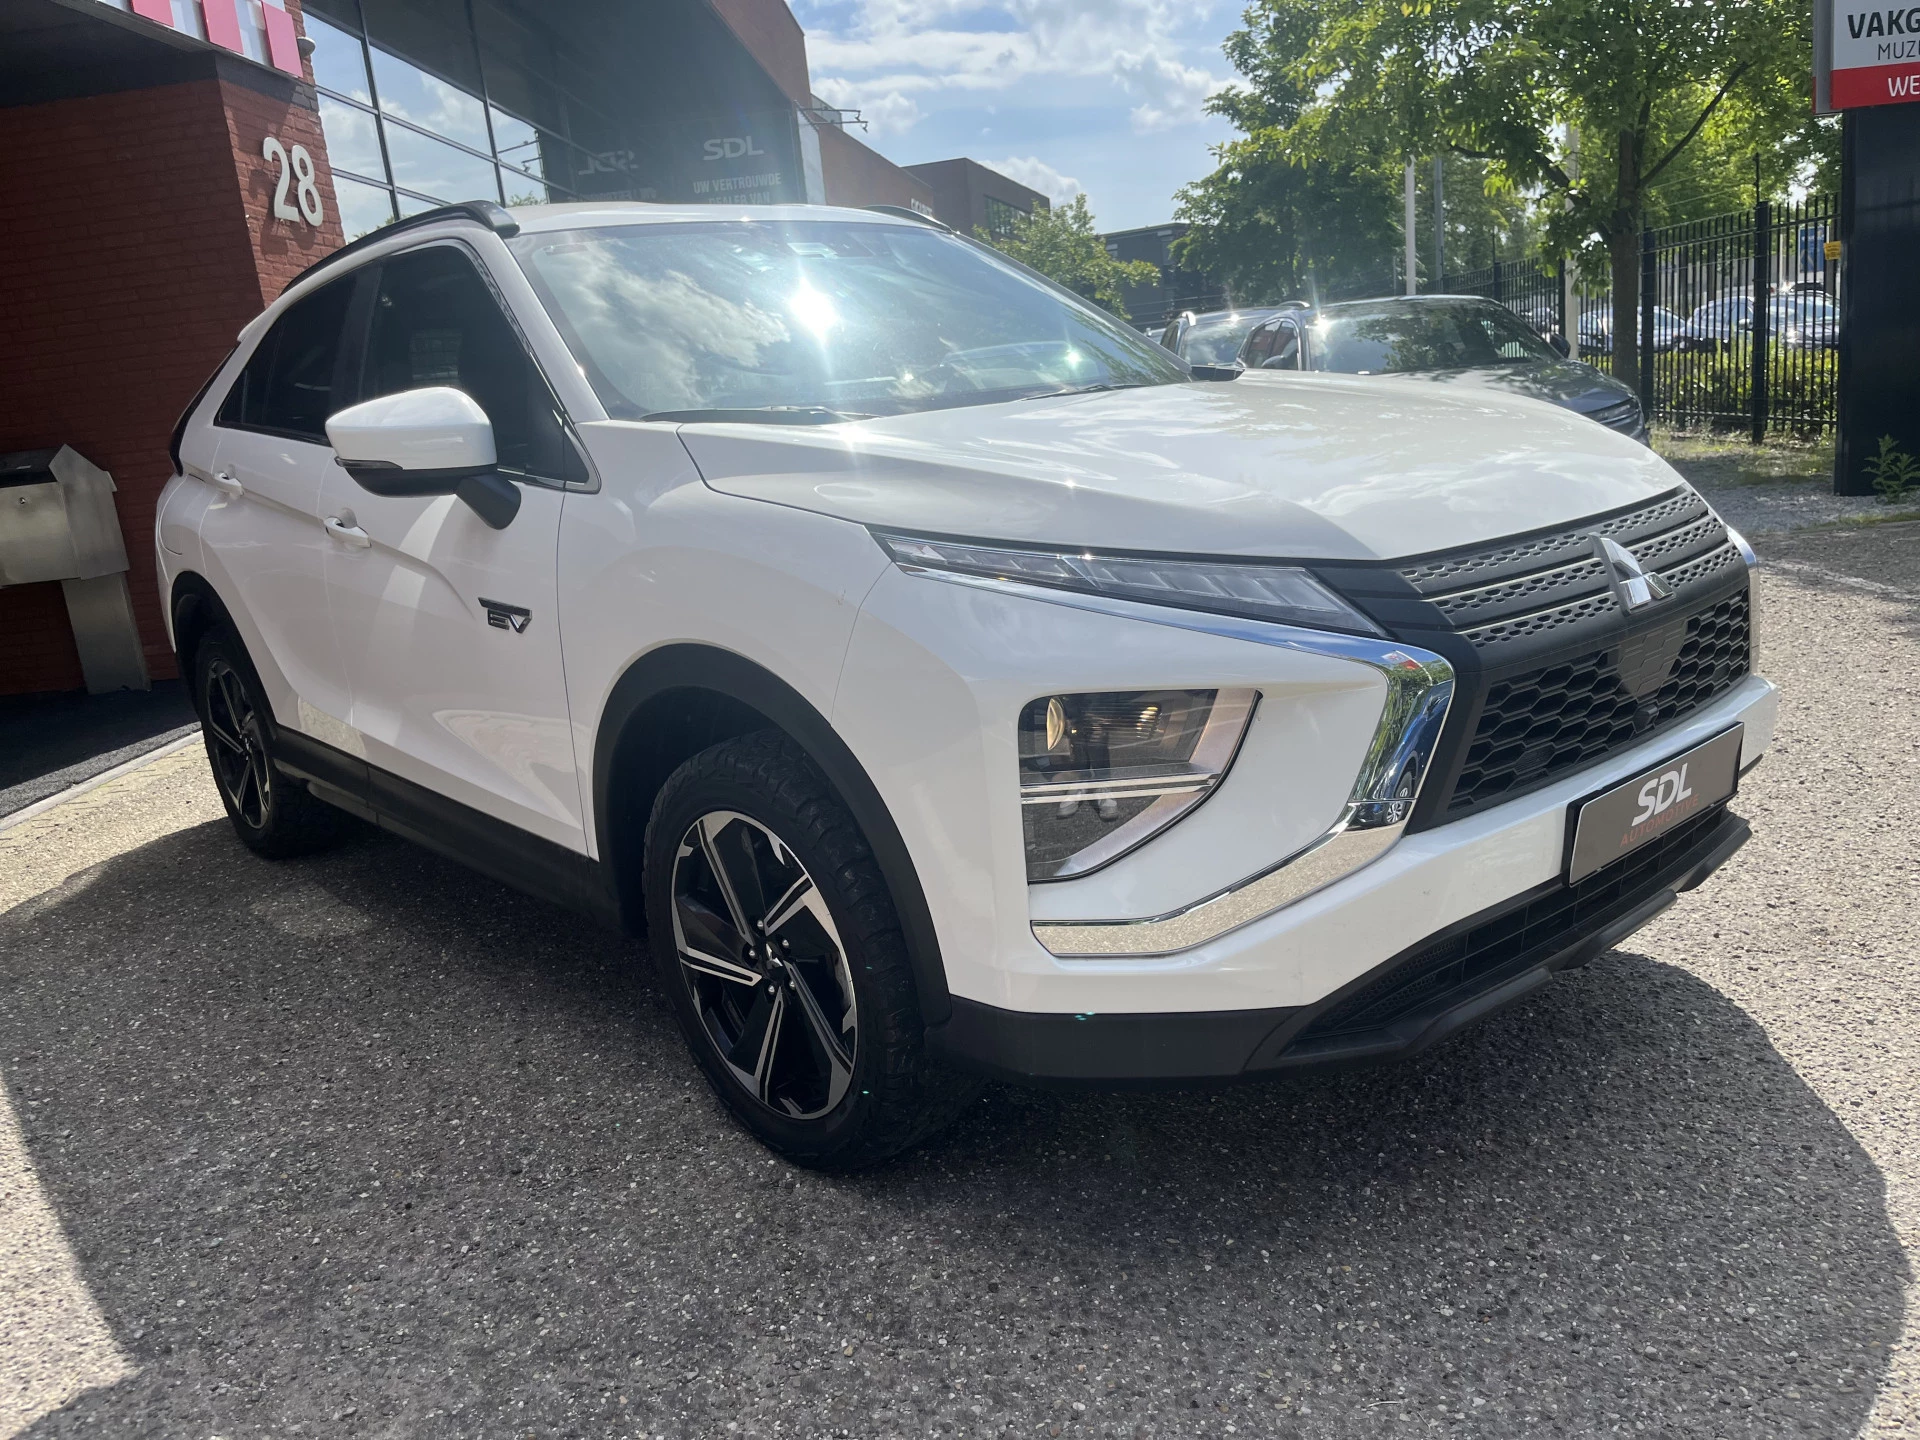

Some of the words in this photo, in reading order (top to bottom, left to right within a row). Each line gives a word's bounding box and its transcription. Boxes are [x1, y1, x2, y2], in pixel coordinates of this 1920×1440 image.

[703, 135, 765, 161] SDL
[263, 136, 324, 227] 28
[693, 180, 710, 194] UW
[712, 172, 782, 192] VERTROUWDE
[1620, 793, 1700, 847] AUTOMOTIVE
[1631, 762, 1692, 827] SDL
